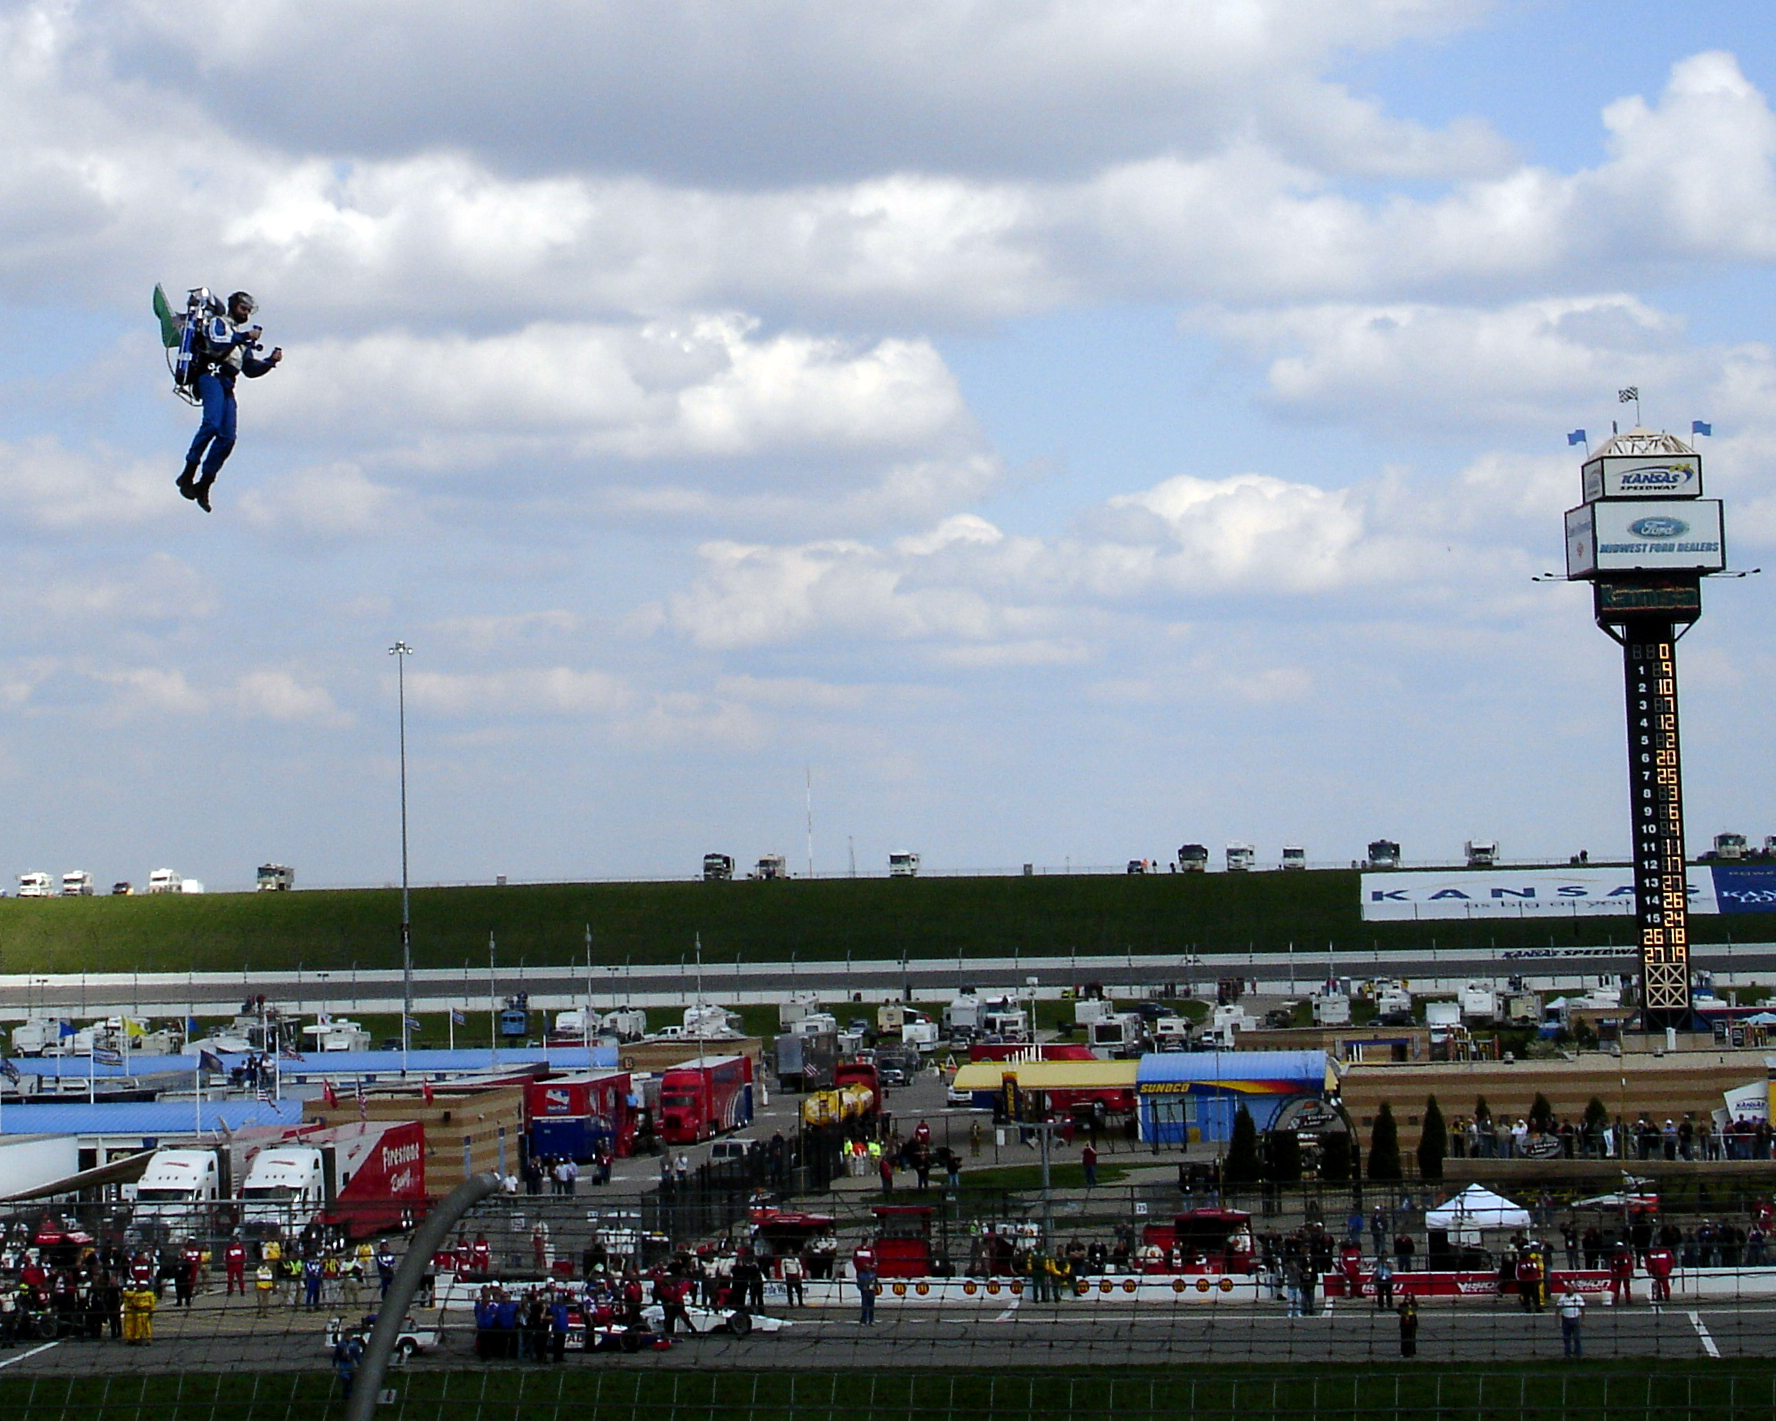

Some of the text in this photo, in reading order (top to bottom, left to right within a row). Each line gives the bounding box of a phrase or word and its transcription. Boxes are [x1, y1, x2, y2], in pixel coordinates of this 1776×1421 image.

[1621, 472, 1680, 484] KANSAS
[1640, 520, 1674, 535] Ford
[1599, 542, 1719, 554] MIDWEST FORD DEALERS
[1638, 662, 1672, 677] 1 9
[1638, 679, 1673, 695] 2 10
[1639, 697, 1674, 712] 3 7
[1640, 714, 1675, 730] 4 12
[1641, 732, 1676, 748] 5 2
[1641, 750, 1676, 766] 6 20
[1642, 768, 1677, 784] 7 25
[1643, 786, 1678, 801] 8 3
[1644, 804, 1679, 819] 9 6
[1642, 821, 1680, 837] 10 4
[1642, 839, 1681, 855] 11 11
[1643, 857, 1682, 872] 12 17
[1644, 875, 1682, 891] 13 27
[1644, 896, 1660, 906] 14
[1663, 893, 1684, 908] 26
[1646, 911, 1684, 927] 15 24
[1643, 928, 1686, 945] 26 18
[1562, 948, 1639, 957] SPEEDWA
[1644, 946, 1686, 963] 27 19
[1140, 1083, 1190, 1093] SUNOCO
[382, 1142, 419, 1174] Firestone
